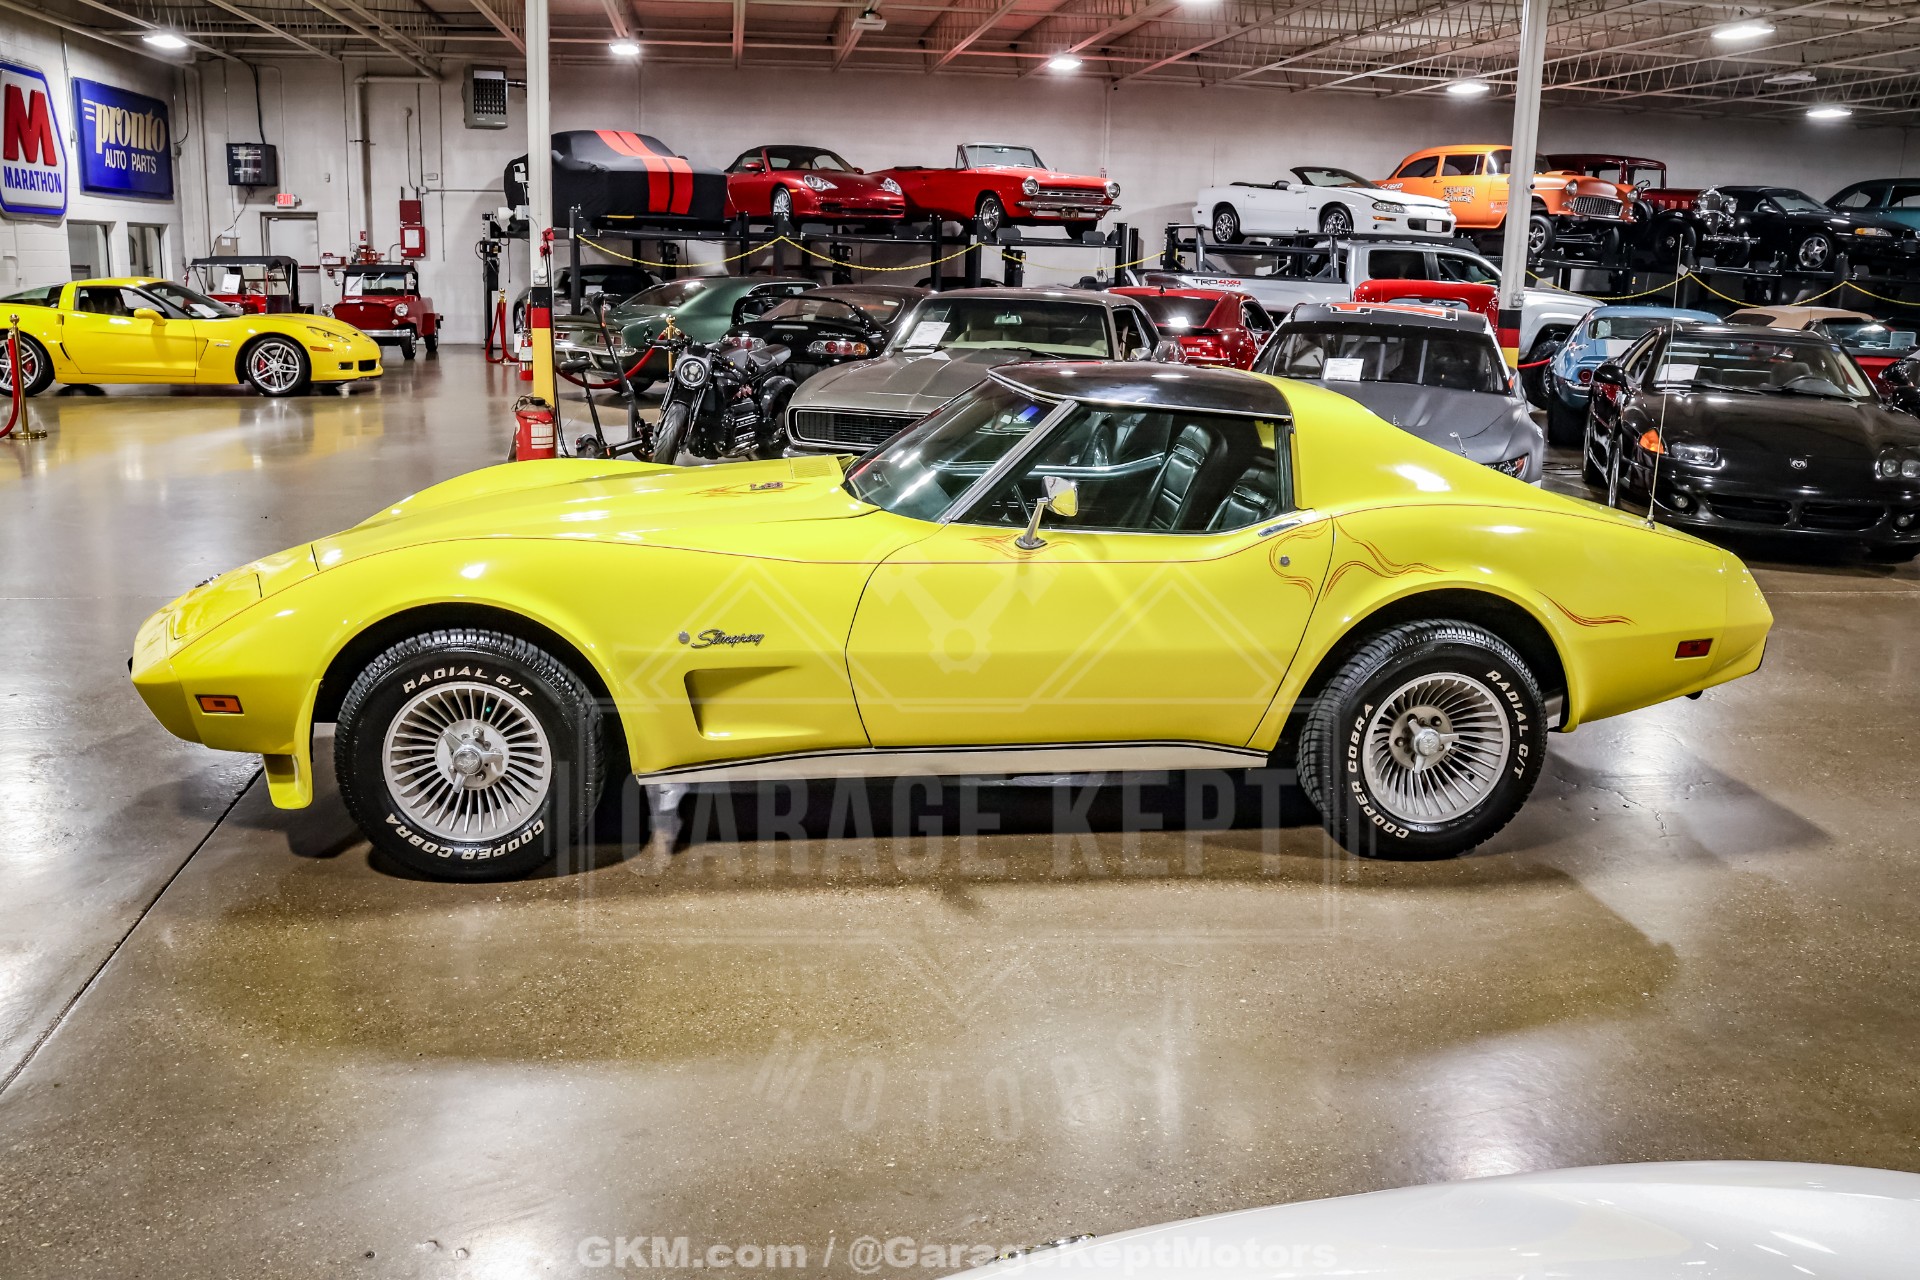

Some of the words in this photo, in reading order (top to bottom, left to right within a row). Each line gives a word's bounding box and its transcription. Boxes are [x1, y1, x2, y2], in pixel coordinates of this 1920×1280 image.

[3, 83, 57, 167] M
[94, 102, 166, 155] pronto
[4, 165, 62, 194] MARATHON
[105, 148, 127, 170] AUTO
[131, 152, 157, 175] PARTS
[277, 193, 292, 205] EXIT
[691, 628, 765, 649] Stingray
[402, 666, 489, 694] RADIAL
[495, 673, 533, 698] G/T
[1347, 702, 1375, 774] COBRA
[1485, 669, 1530, 738] RADIAL
[1513, 744, 1530, 780] G/T
[1350, 780, 1410, 839] COOPER
[385, 812, 454, 859] COBRA
[461, 818, 546, 861] COOPER
